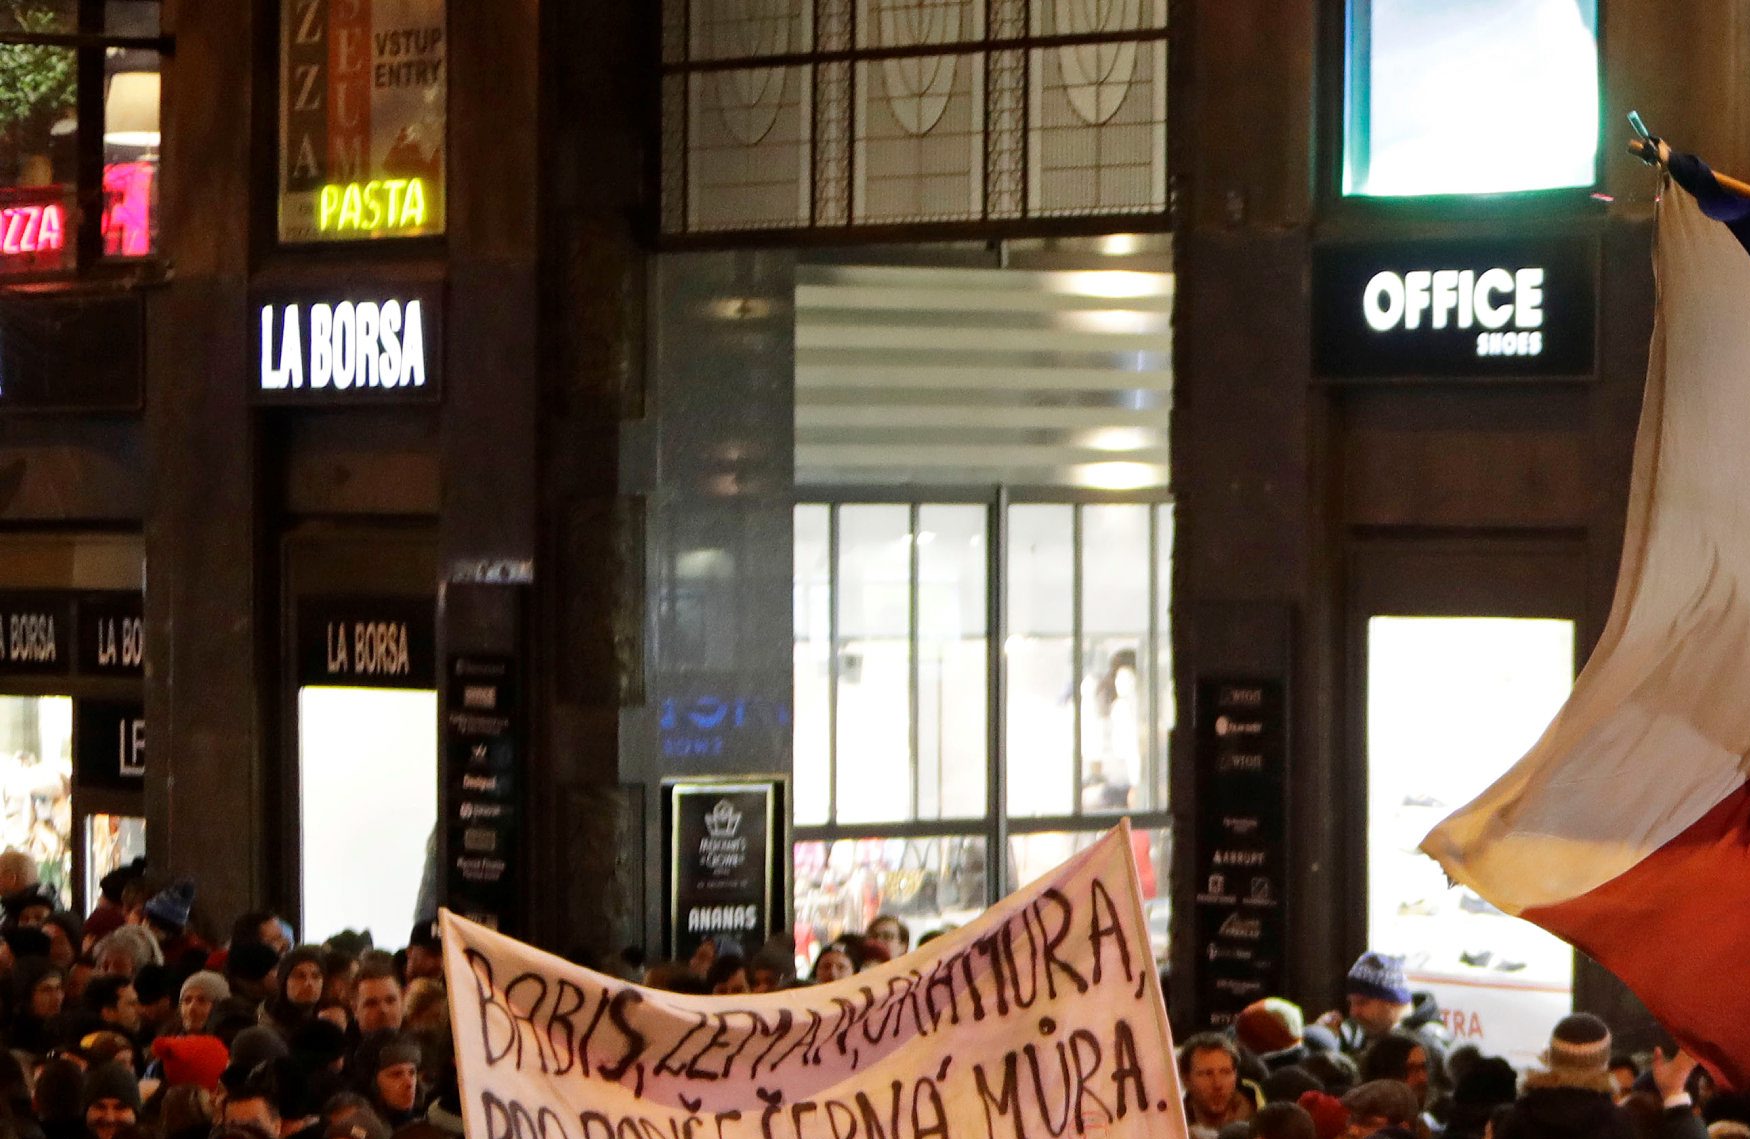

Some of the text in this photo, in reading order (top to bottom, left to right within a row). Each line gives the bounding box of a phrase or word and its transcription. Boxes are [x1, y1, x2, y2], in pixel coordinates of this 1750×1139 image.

[375, 28, 442, 56] VSTUP
[375, 60, 442, 88] ENTRY
[318, 177, 426, 232] PASTA
[1362, 267, 1544, 332] OFFICE
[260, 300, 425, 389] LA BORSA
[1477, 332, 1542, 357] SHOES
[10, 613, 56, 662] BORSA
[98, 616, 117, 666] LA
[327, 622, 410, 675] LA BORSA
[688, 904, 757, 933] ANANAS
